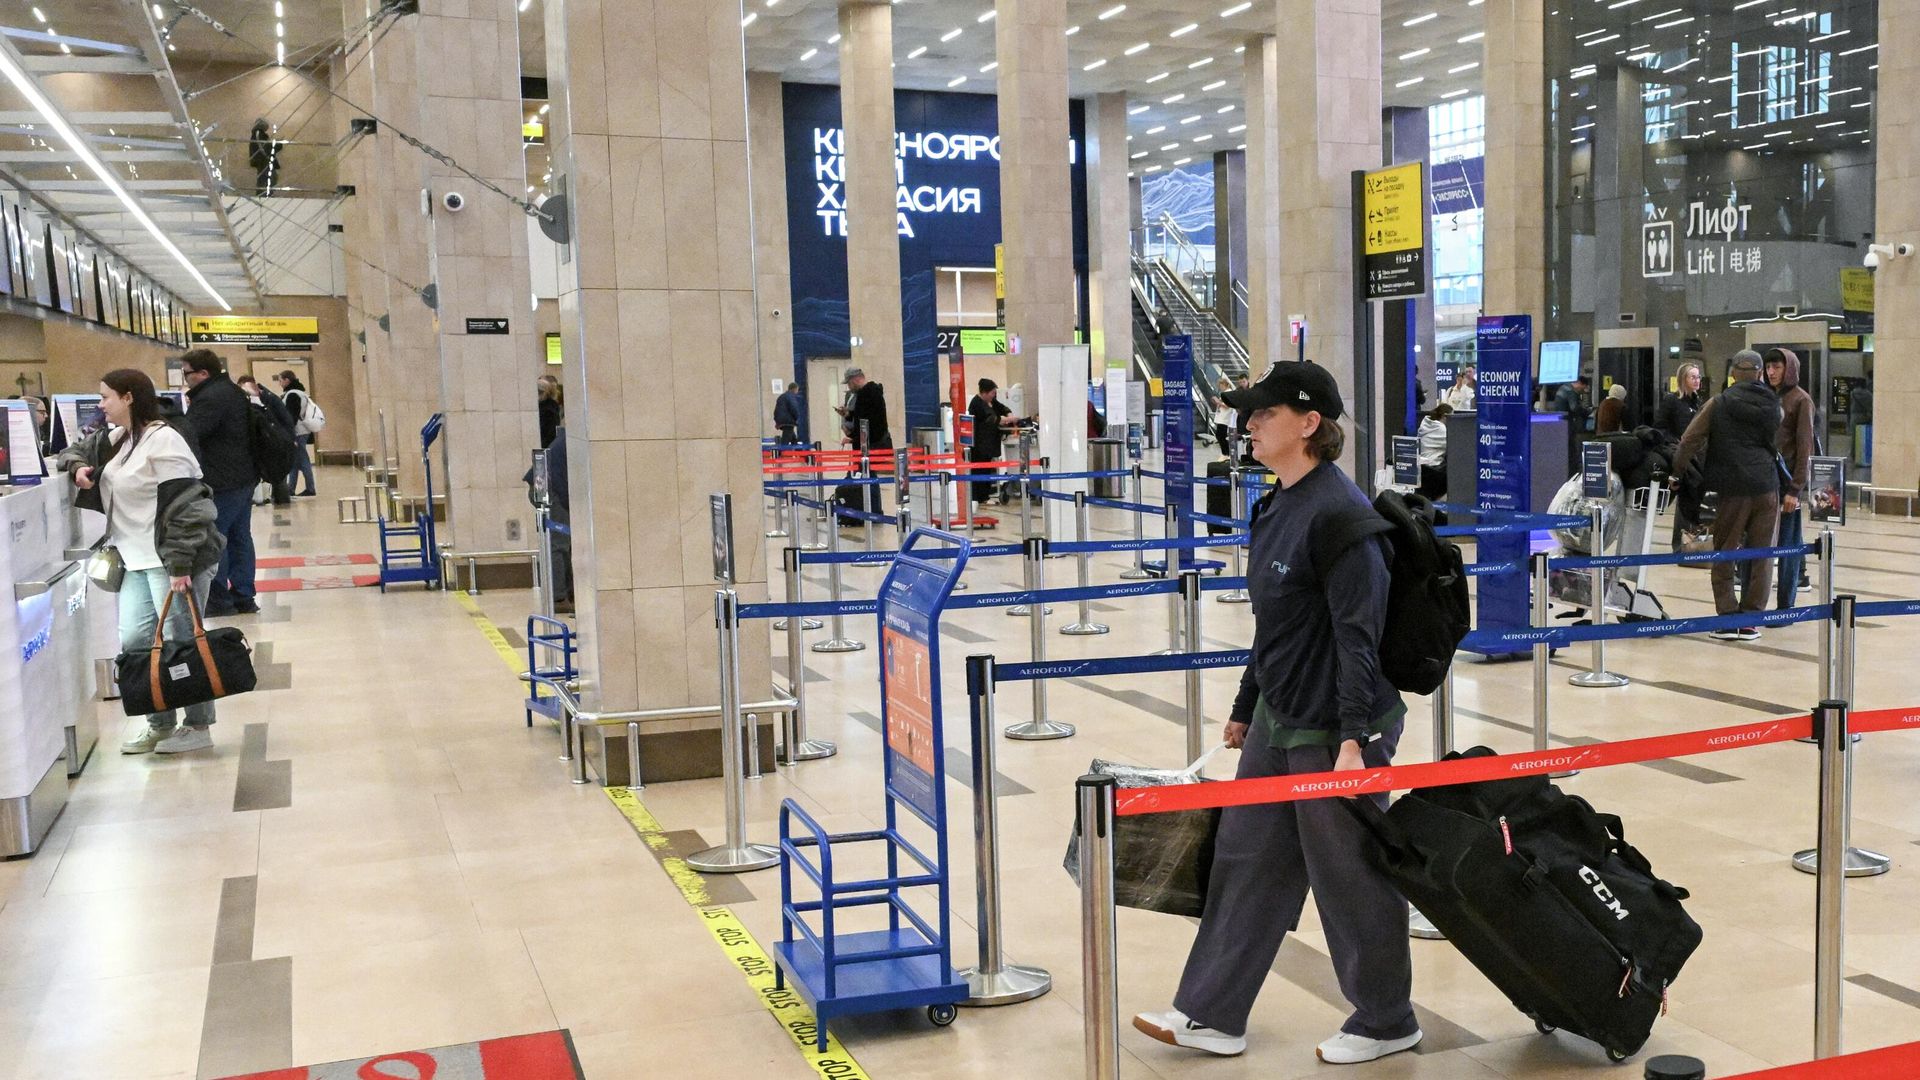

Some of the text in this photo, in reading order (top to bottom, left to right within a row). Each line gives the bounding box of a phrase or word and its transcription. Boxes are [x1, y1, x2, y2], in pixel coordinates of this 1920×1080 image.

[816, 182, 981, 213] ХАСИЯ
[1687, 199, 1752, 242] Лифт
[1687, 246, 1762, 275] Lift 电梯
[937, 332, 958, 349] 27
[1435, 368, 1452, 376] OLO
[1480, 371, 1521, 383] ECONOMY
[1164, 389, 1188, 397] DROP-OFF
[1480, 385, 1519, 397] CHECK-IN
[1480, 434, 1491, 446] 40
[1480, 468, 1491, 480] 20
[1684, 553, 1712, 561] AEROFLOT
[1773, 547, 1799, 555] AEROFLOT
[1106, 586, 1144, 595] AEROFLOT
[976, 596, 1017, 604] AEROFLOT
[1763, 611, 1800, 621] AEROFLOT
[1637, 624, 1677, 633] AEROFLOT
[1501, 631, 1543, 641] AEROFLOT
[1191, 655, 1242, 665] AEROFLOT
[1019, 666, 1073, 676] AEROFLOT
[1707, 731, 1763, 746] AEROFLOT
[1510, 756, 1572, 771] AEROFLOT
[1291, 779, 1361, 793] AEROFLOT
[1578, 865, 1629, 921] CCM
[716, 927, 749, 947] STOP
[736, 955, 773, 977] STOP
[762, 987, 800, 1010] STOP
